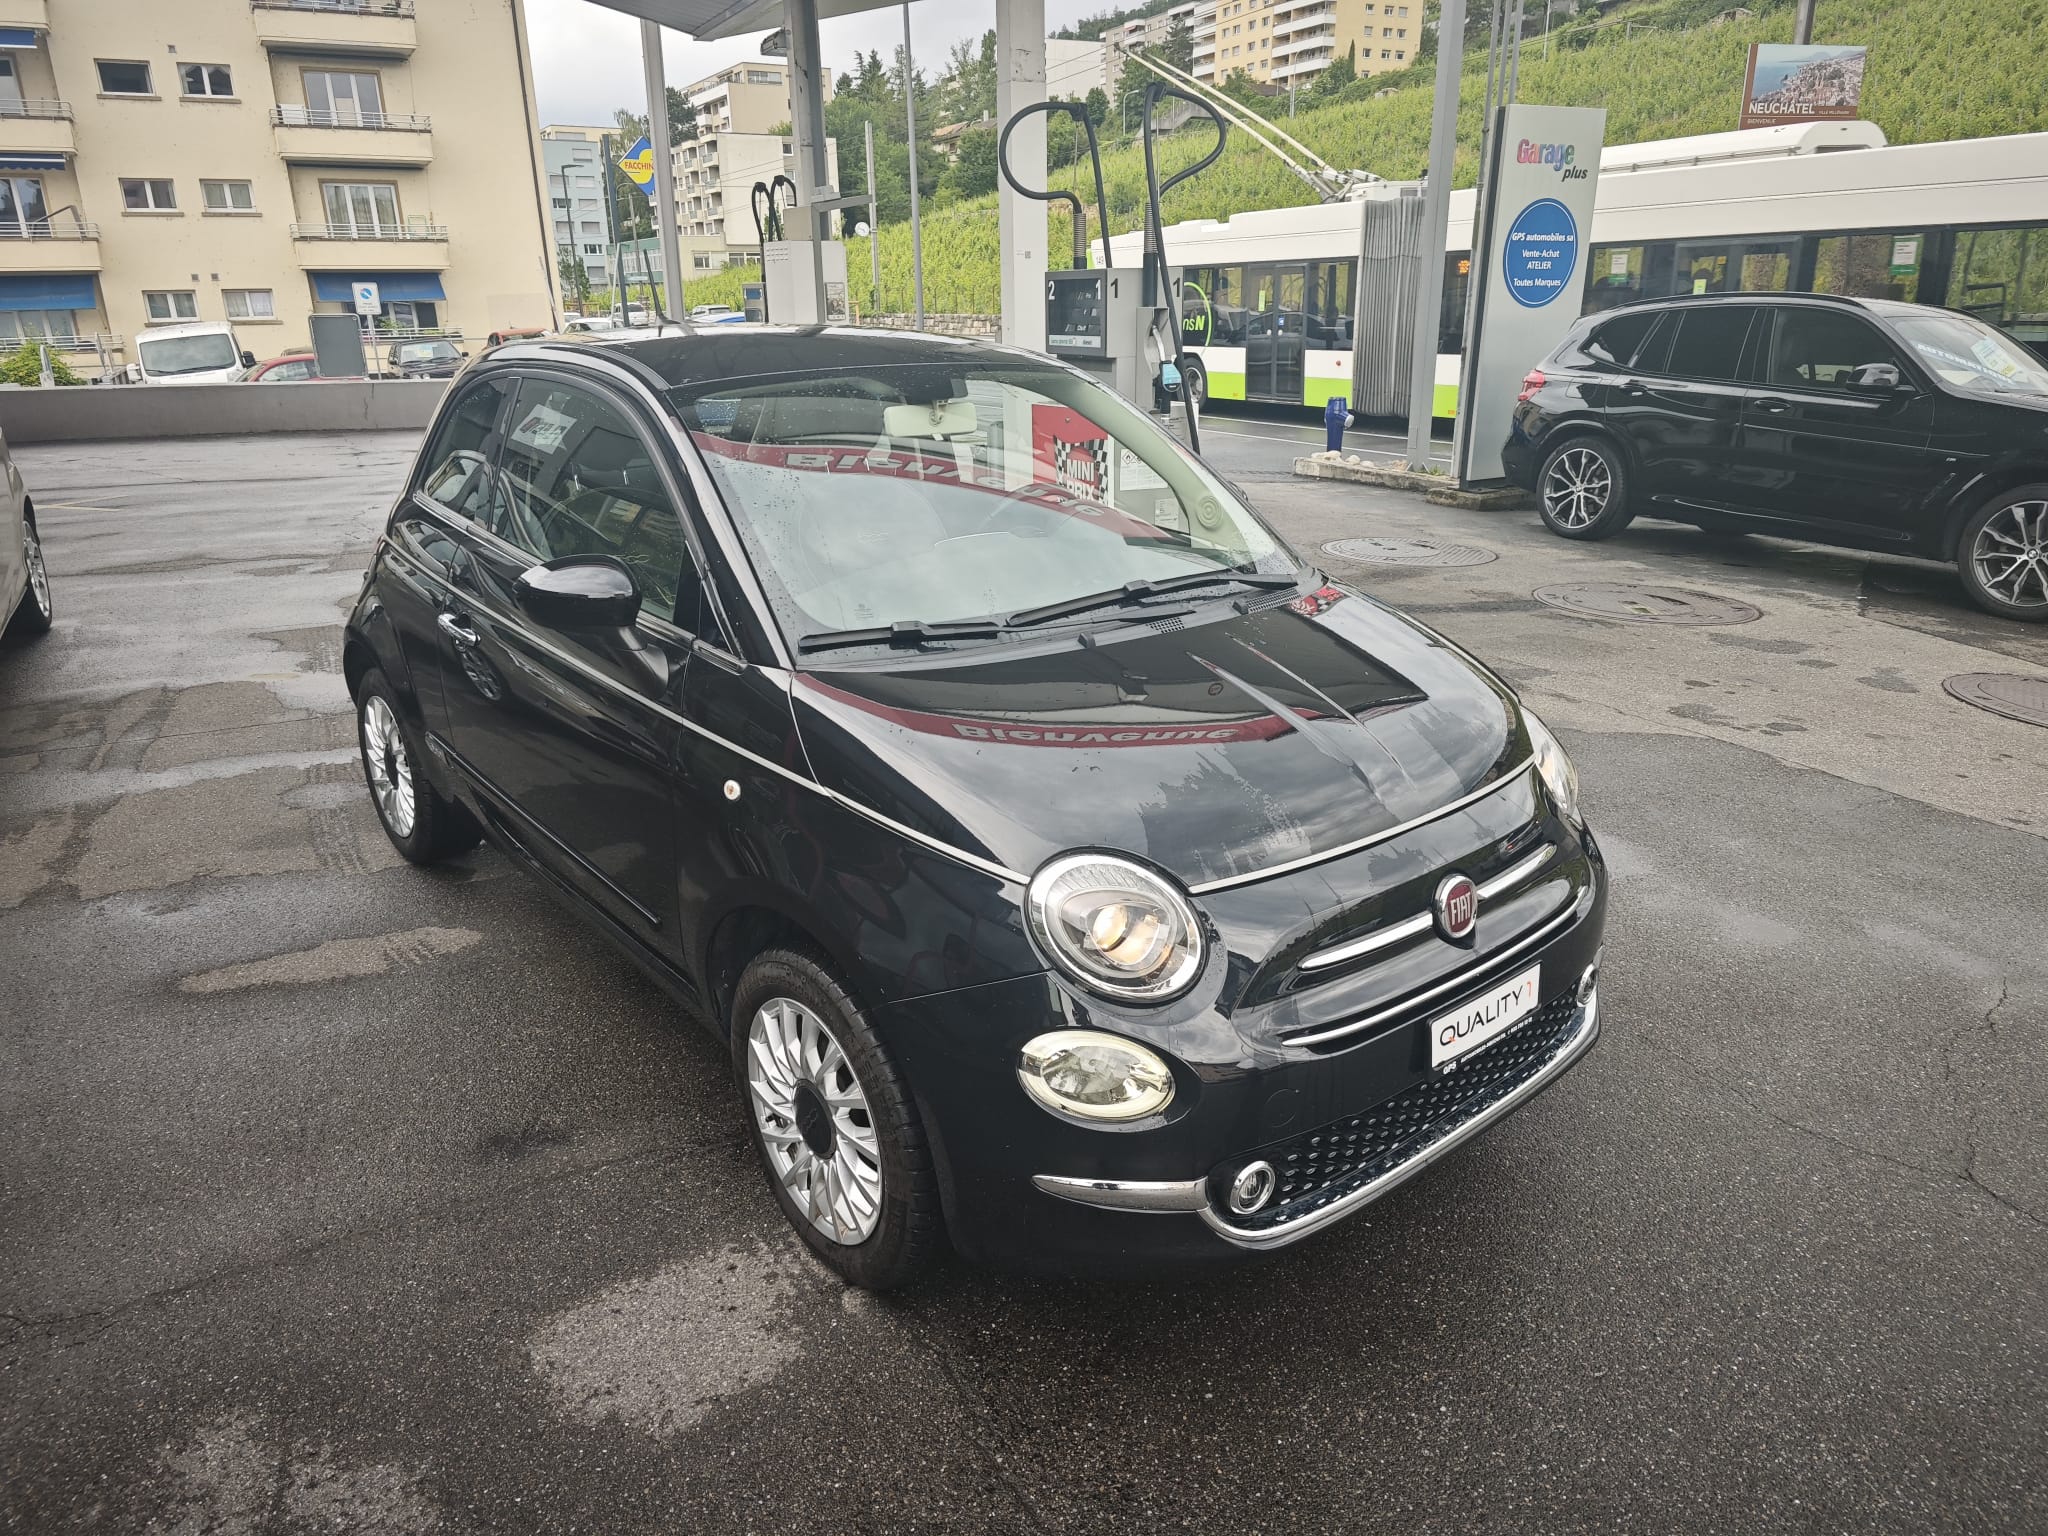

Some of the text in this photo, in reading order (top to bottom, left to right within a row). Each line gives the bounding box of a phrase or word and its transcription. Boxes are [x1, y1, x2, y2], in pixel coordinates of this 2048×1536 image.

[1748, 101, 1815, 114] NEUCHÂTEL
[1517, 139, 1575, 172] Garage
[1561, 165, 1589, 182] plus
[1512, 232, 1526, 241] GPS
[1526, 232, 1566, 242] automobiles
[1522, 249, 1560, 258] Vente-Achat
[1527, 261, 1552, 270] ATELIER
[1047, 280, 1056, 300] 2
[1095, 279, 1102, 300] 1
[1110, 277, 1119, 299] 1
[1172, 277, 1181, 298] 1
[1514, 278, 1562, 289] Toutes Marques
[1066, 458, 1095, 482] MINI
[1450, 891, 1471, 926] FIAT
[1440, 984, 1524, 1046] QUALITY
[1442, 1061, 1457, 1075] GPS
